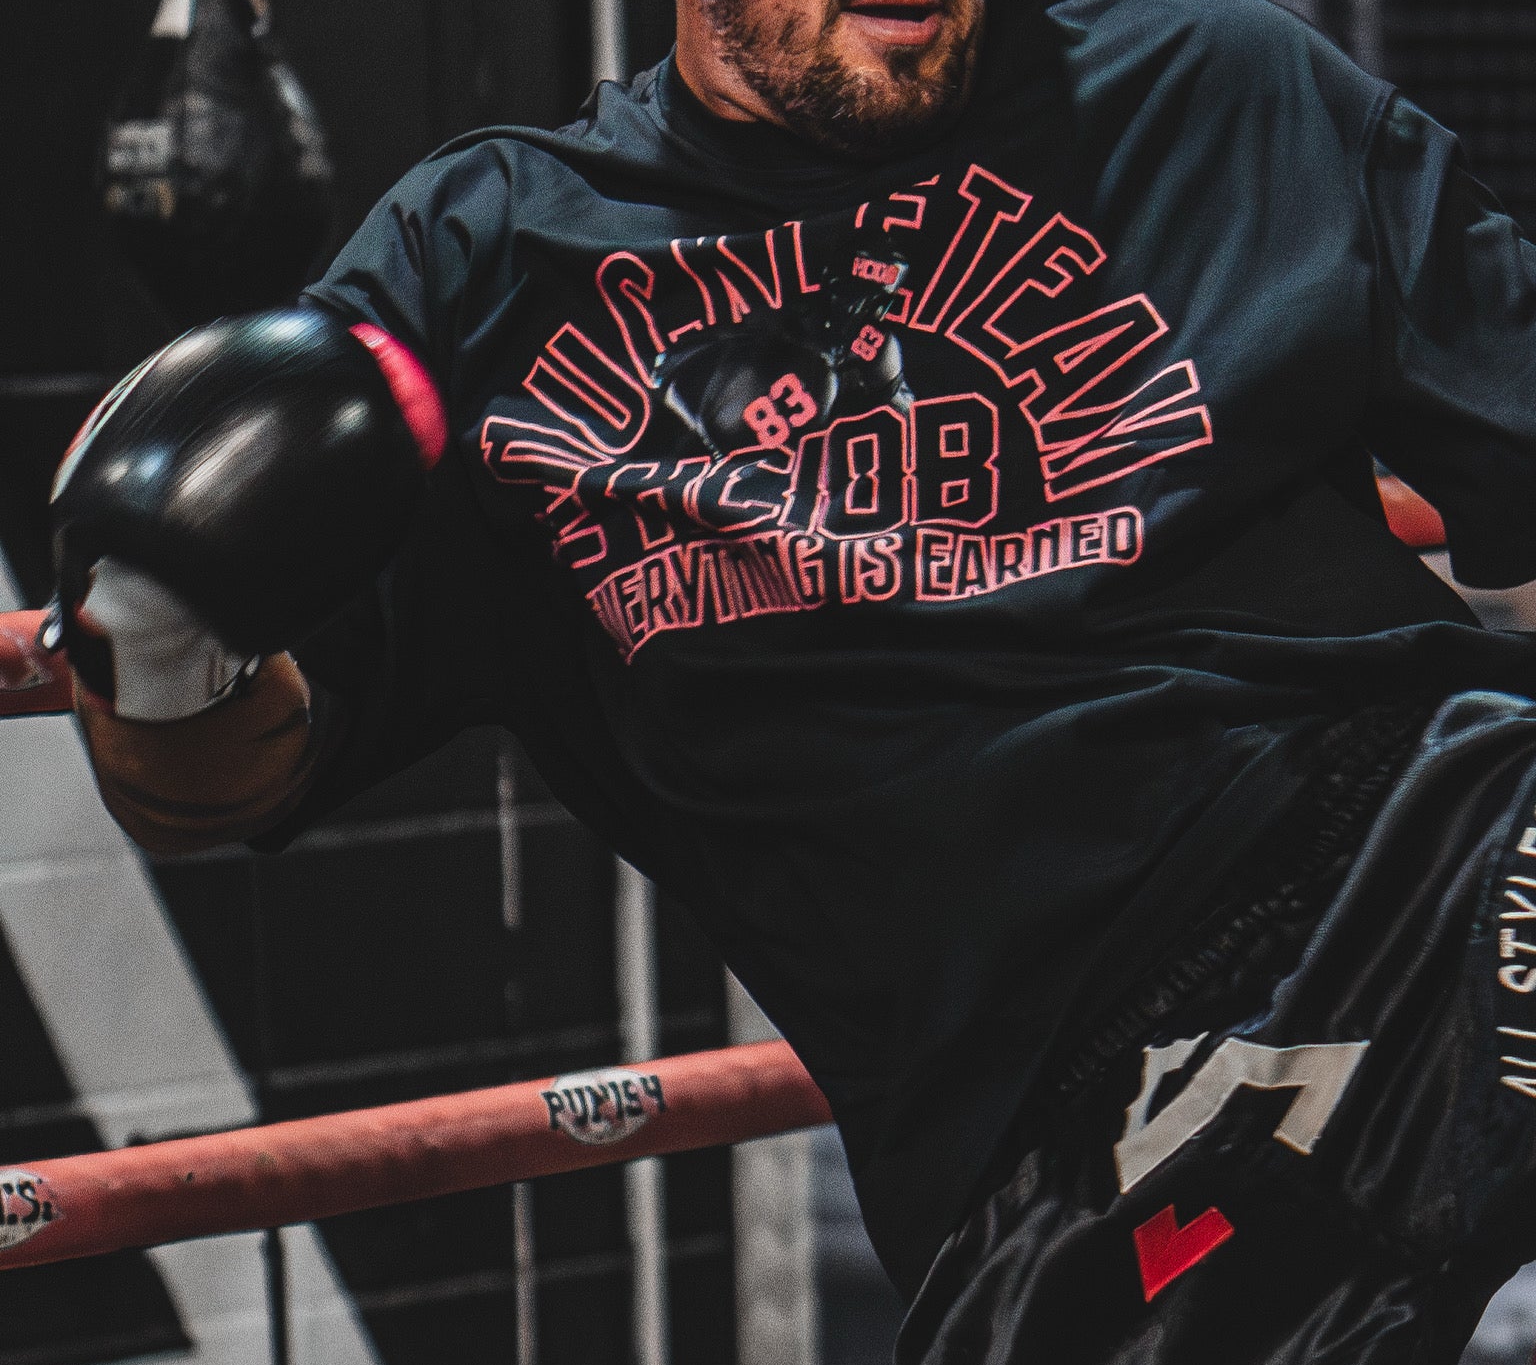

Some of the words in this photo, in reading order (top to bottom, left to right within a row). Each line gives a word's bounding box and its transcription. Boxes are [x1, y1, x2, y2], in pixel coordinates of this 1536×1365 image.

[907, 163, 1214, 503] TEAM
[742, 372, 818, 449] 83
[838, 532, 903, 604] IS
[916, 505, 1144, 602] EARNED
